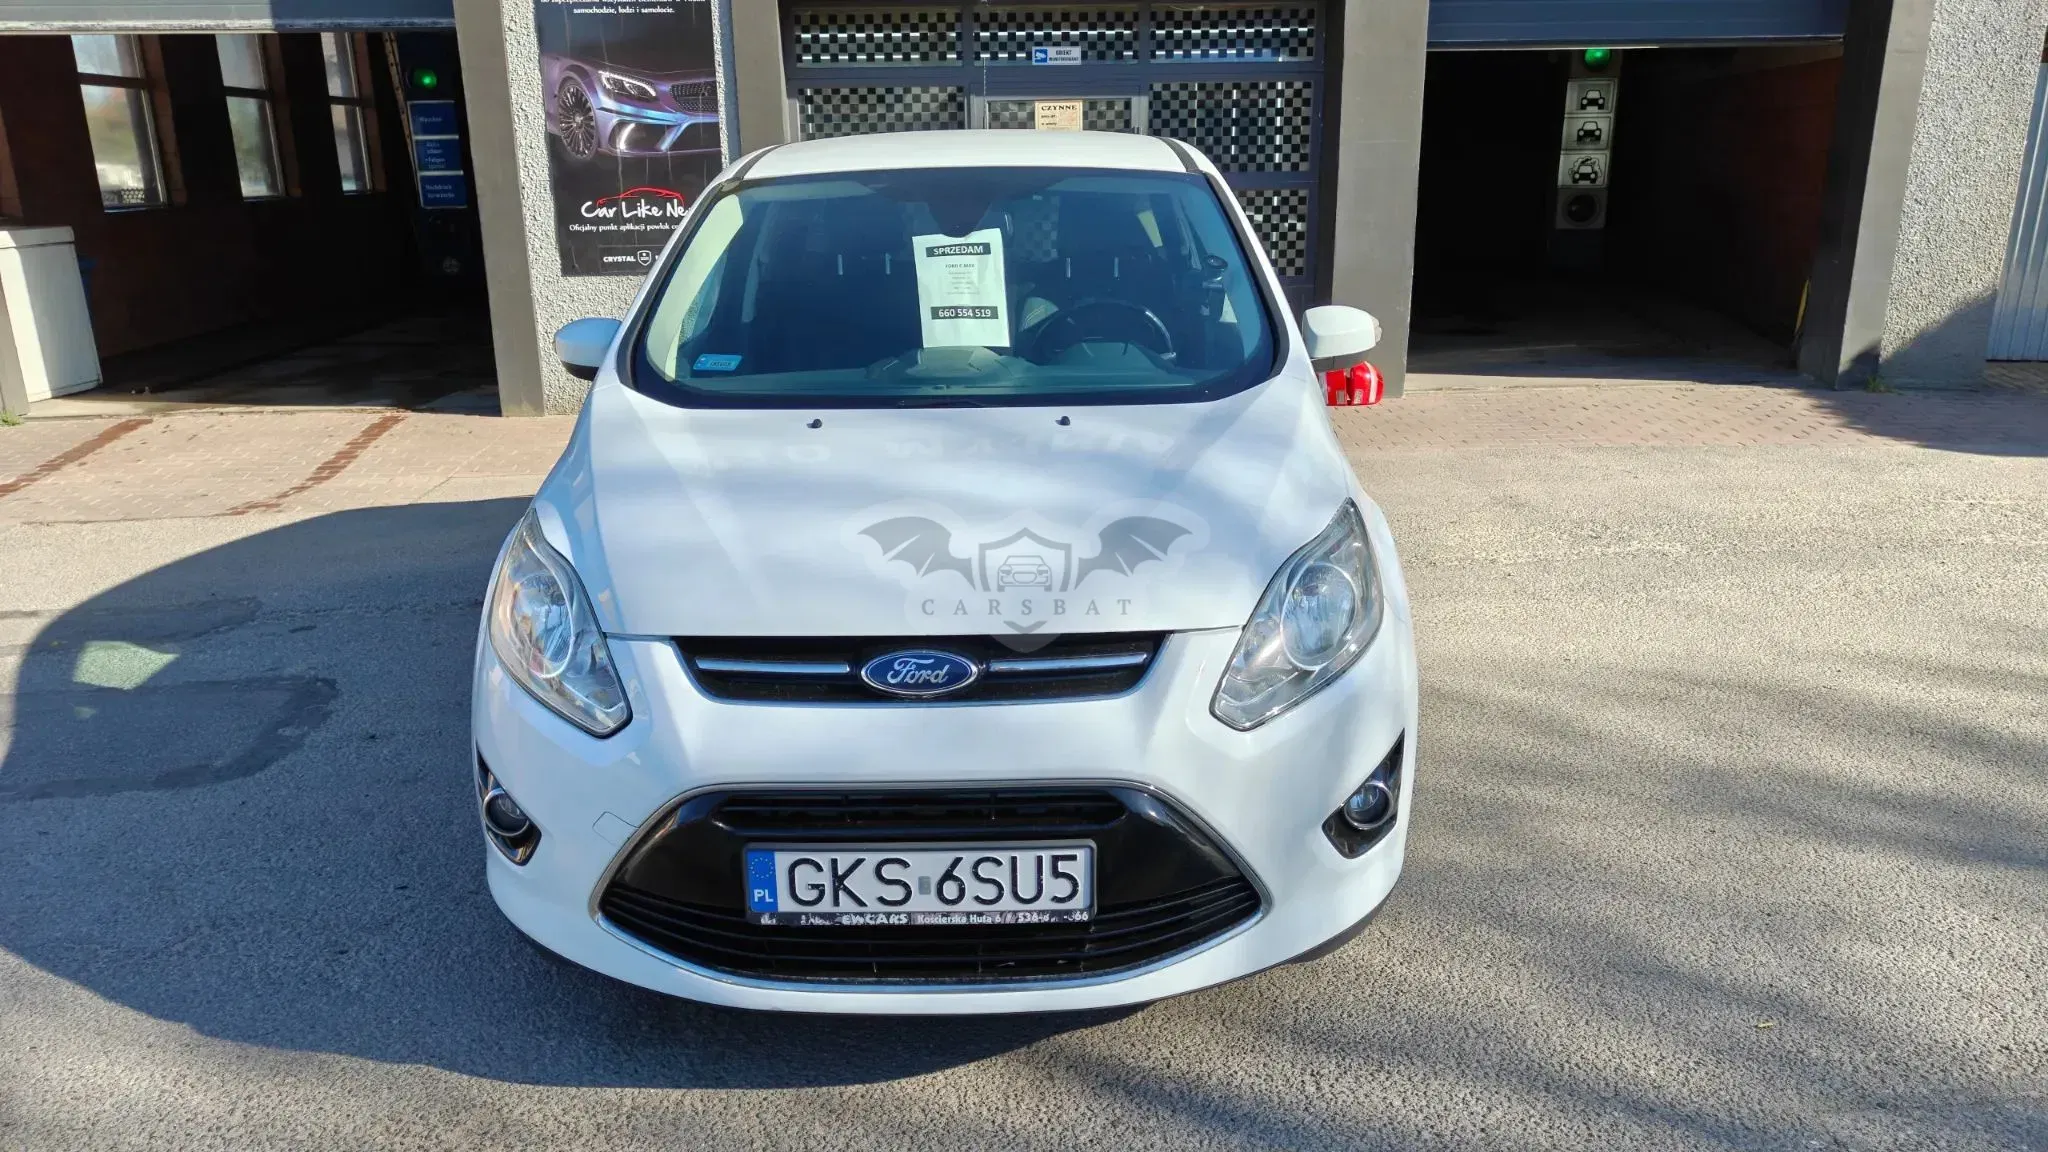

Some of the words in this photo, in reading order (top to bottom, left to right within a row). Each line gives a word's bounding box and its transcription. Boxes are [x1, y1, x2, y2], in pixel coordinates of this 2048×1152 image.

[581, 201, 617, 218] Car
[621, 199, 662, 218] Like
[666, 199, 690, 217] Ne
[569, 224, 598, 233] Oficjalny
[599, 223, 619, 232] punkt
[619, 223, 646, 232] aplikacji
[933, 245, 984, 255] SPRZEDAM
[603, 255, 637, 263] CRYSTAL
[938, 308, 955, 317] 660
[957, 308, 973, 317] 554
[975, 308, 991, 317] 519
[886, 657, 950, 684] Ford
[787, 856, 914, 908] GKS
[936, 853, 1080, 906] 6SU5
[753, 888, 774, 903] PL
